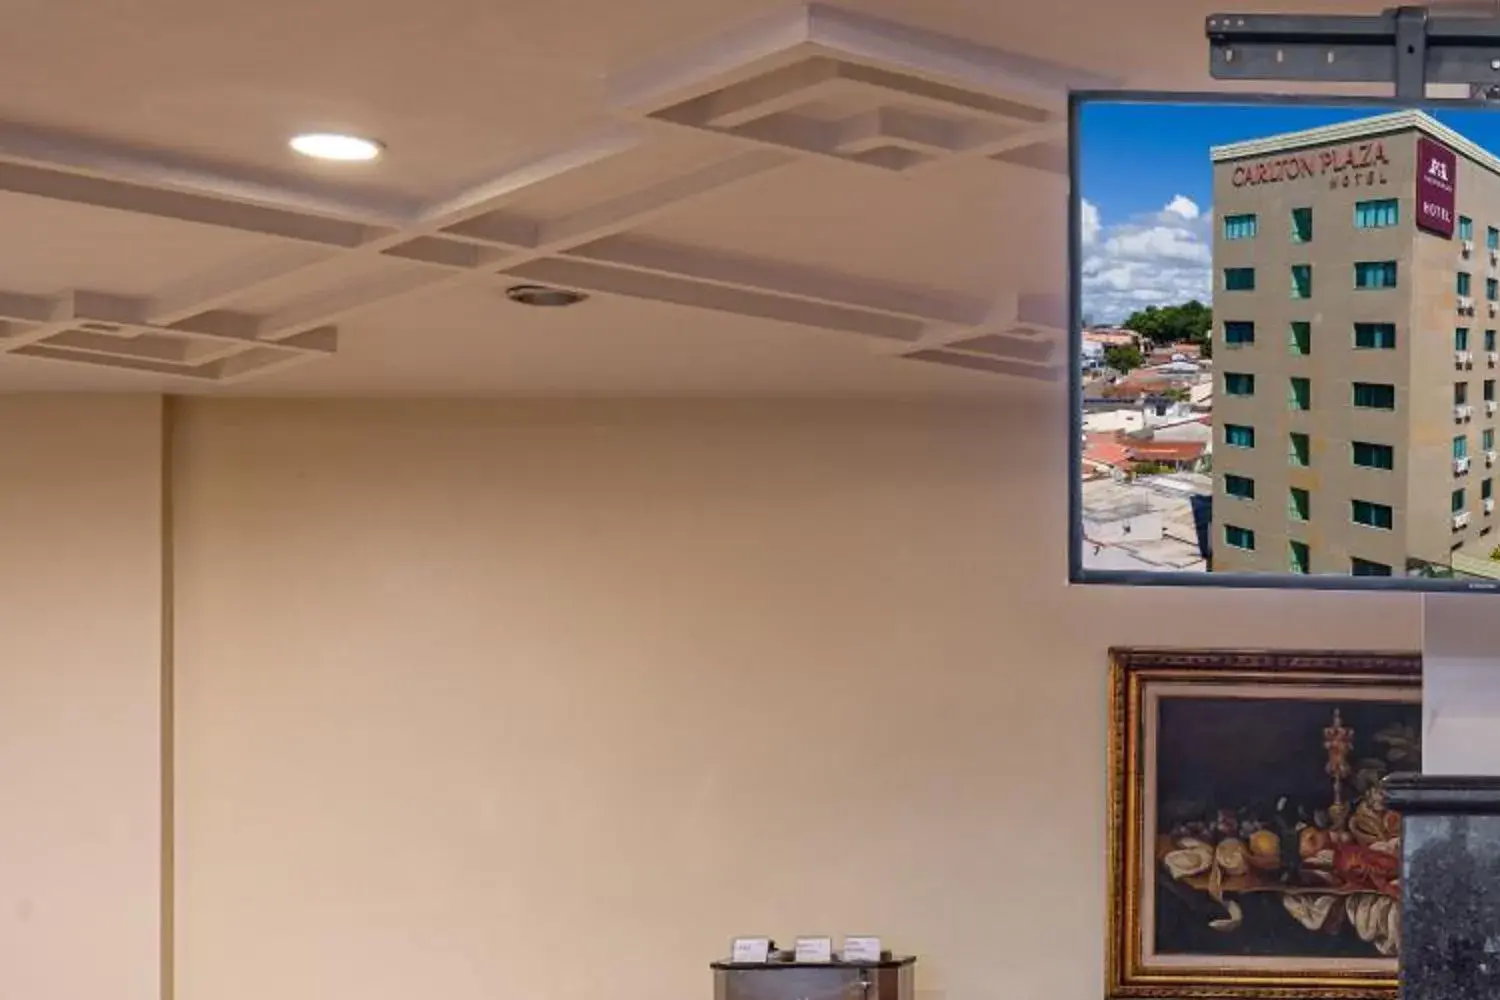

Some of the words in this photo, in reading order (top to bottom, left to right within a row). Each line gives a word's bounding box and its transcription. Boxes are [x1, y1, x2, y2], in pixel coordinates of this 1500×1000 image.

[1232, 155, 1314, 188] CARLTON
[1318, 140, 1390, 174] PLAZA
[1329, 170, 1388, 190] HOTEL
[1423, 200, 1451, 223] HOTEL
